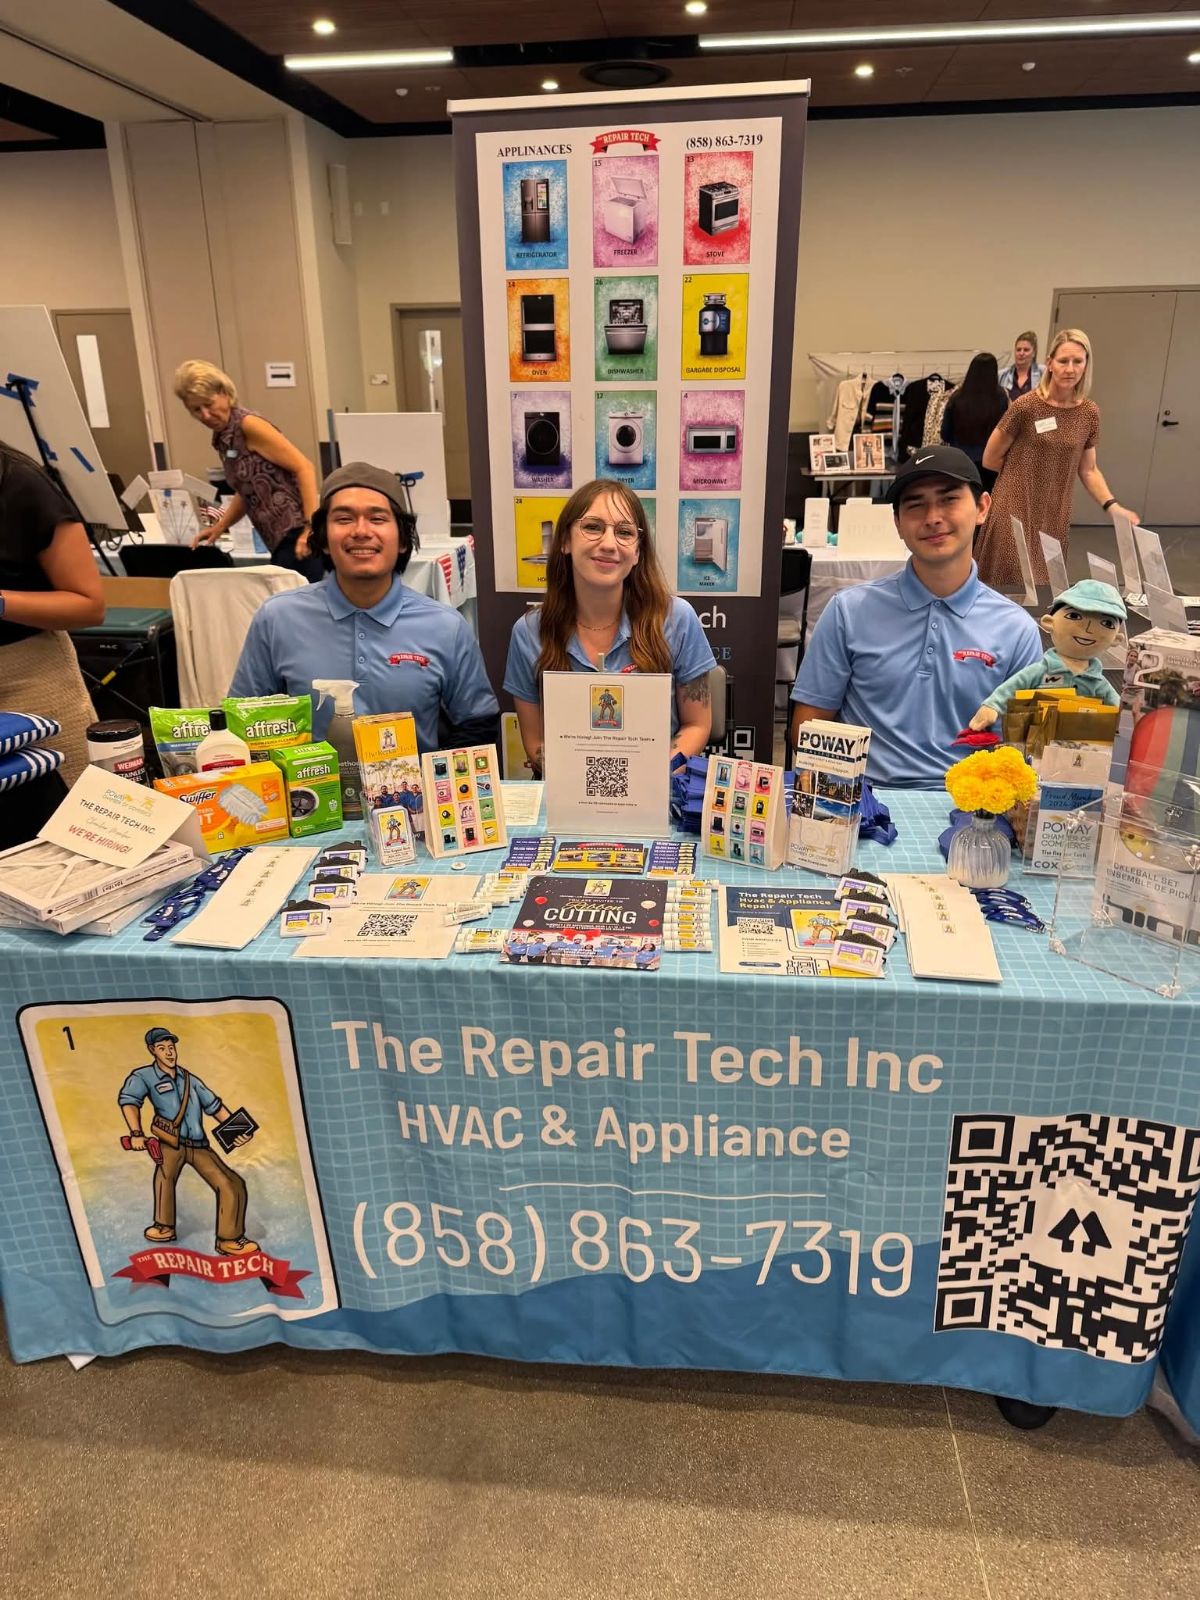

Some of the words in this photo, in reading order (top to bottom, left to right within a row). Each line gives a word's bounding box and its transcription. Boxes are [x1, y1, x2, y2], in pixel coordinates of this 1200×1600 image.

[603, 132, 629, 142] REPAIR
[631, 132, 650, 142] TECH
[686, 136, 713, 150] (858)
[715, 134, 763, 147] 863-7319
[496, 144, 573, 158] APPLINANCES
[1134, 650, 1164, 690] 2
[172, 720, 212, 738] affre
[246, 718, 297, 738] affresh
[800, 732, 856, 756] POWAY
[296, 764, 330, 779] affresh
[179, 791, 216, 804] Swiffer
[80, 798, 94, 810] THE
[94, 804, 120, 820] REPAIR
[120, 816, 141, 828] TECH
[68, 824, 98, 842] WE'RE
[96, 836, 133, 854] HIRING!
[1034, 861, 1058, 869] COX
[1154, 883, 1166, 893] DE
[1161, 877, 1179, 887] SET
[544, 908, 638, 924] CUTTING
[62, 1026, 75, 1051] 1
[330, 1020, 444, 1075] The
[460, 1026, 656, 1088] Repair
[672, 1030, 824, 1088] Tech
[846, 1036, 945, 1094] Inc
[397, 1100, 524, 1150] HVAC
[540, 1104, 577, 1148] &
[594, 1106, 851, 1164] Appliance
[352, 1201, 546, 1284] (858)
[136, 1253, 152, 1264] THE
[155, 1252, 213, 1278] REPAIR
[218, 1253, 274, 1279] TECH
